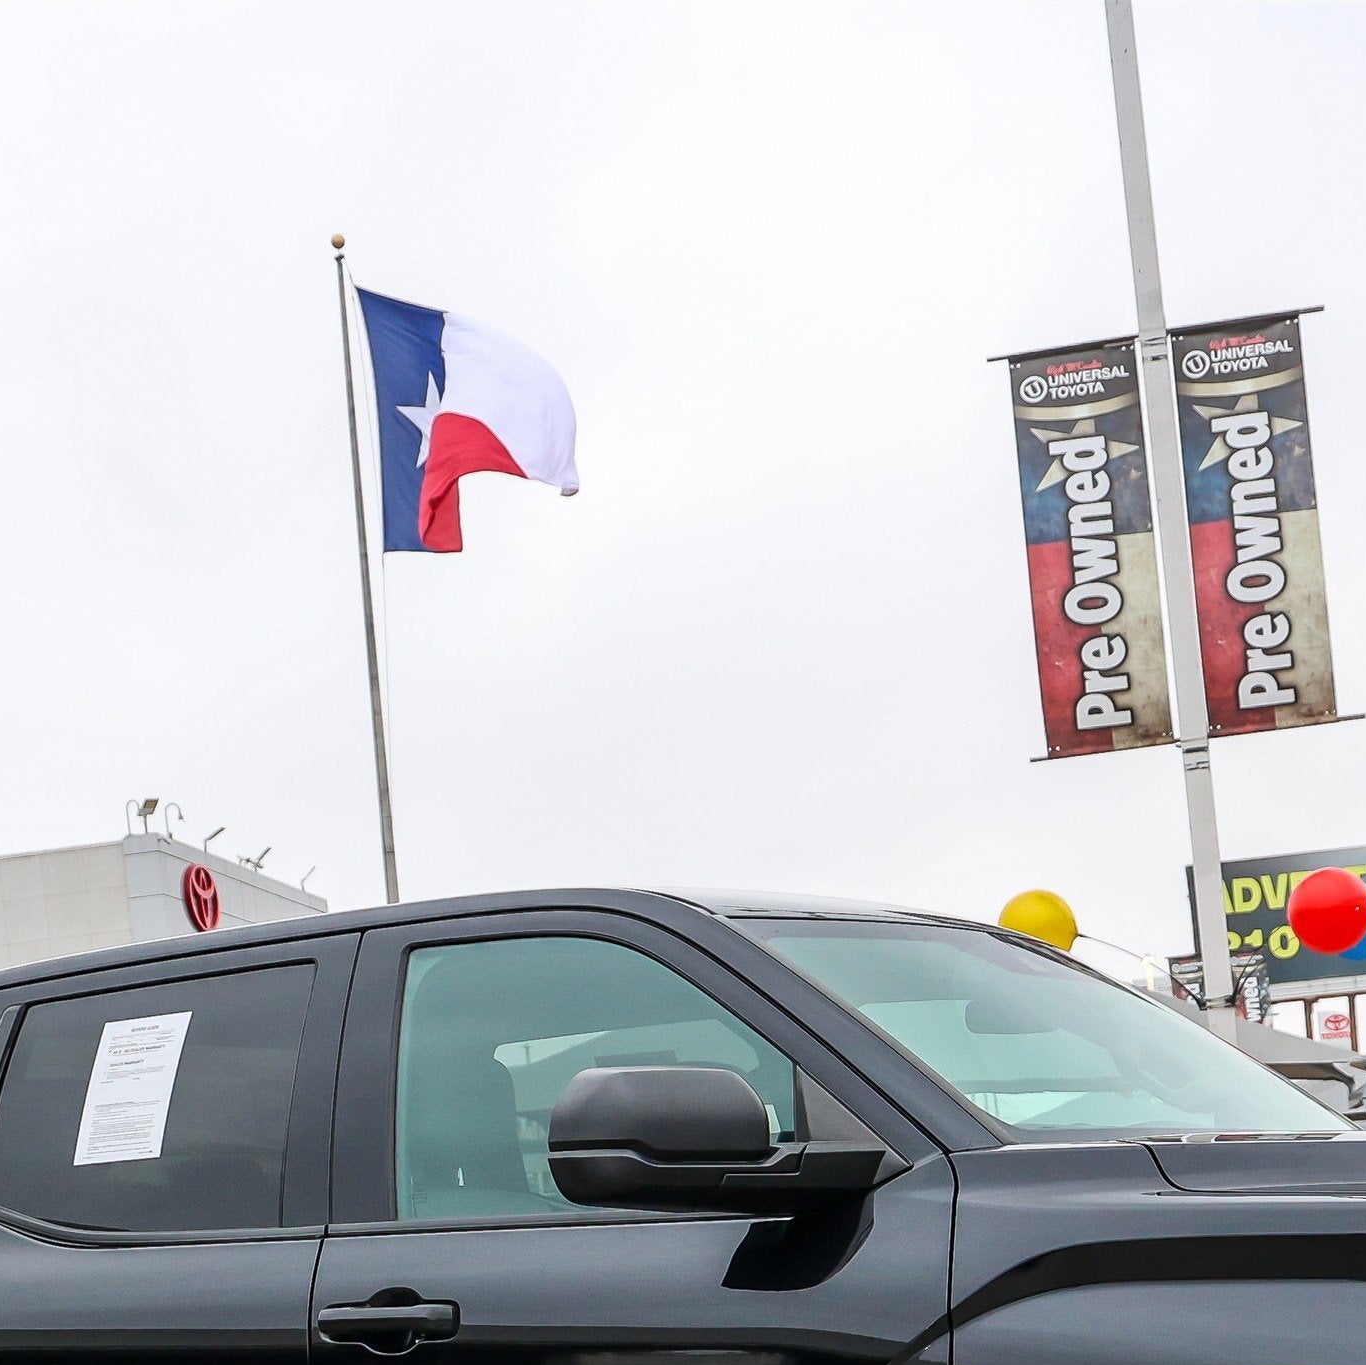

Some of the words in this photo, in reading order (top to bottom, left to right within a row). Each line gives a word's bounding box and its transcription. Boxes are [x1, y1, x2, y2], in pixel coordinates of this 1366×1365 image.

[1048, 364, 1129, 387] UNIVERSAL
[1210, 339, 1293, 362] UNIVERSAL
[1211, 355, 1269, 375] TOYOTA
[1049, 381, 1105, 400] TOYOTA
[1048, 435, 1123, 625] Owned
[1211, 411, 1286, 603] Owned
[1076, 635, 1132, 731] Pre
[1239, 613, 1296, 710] Pre
